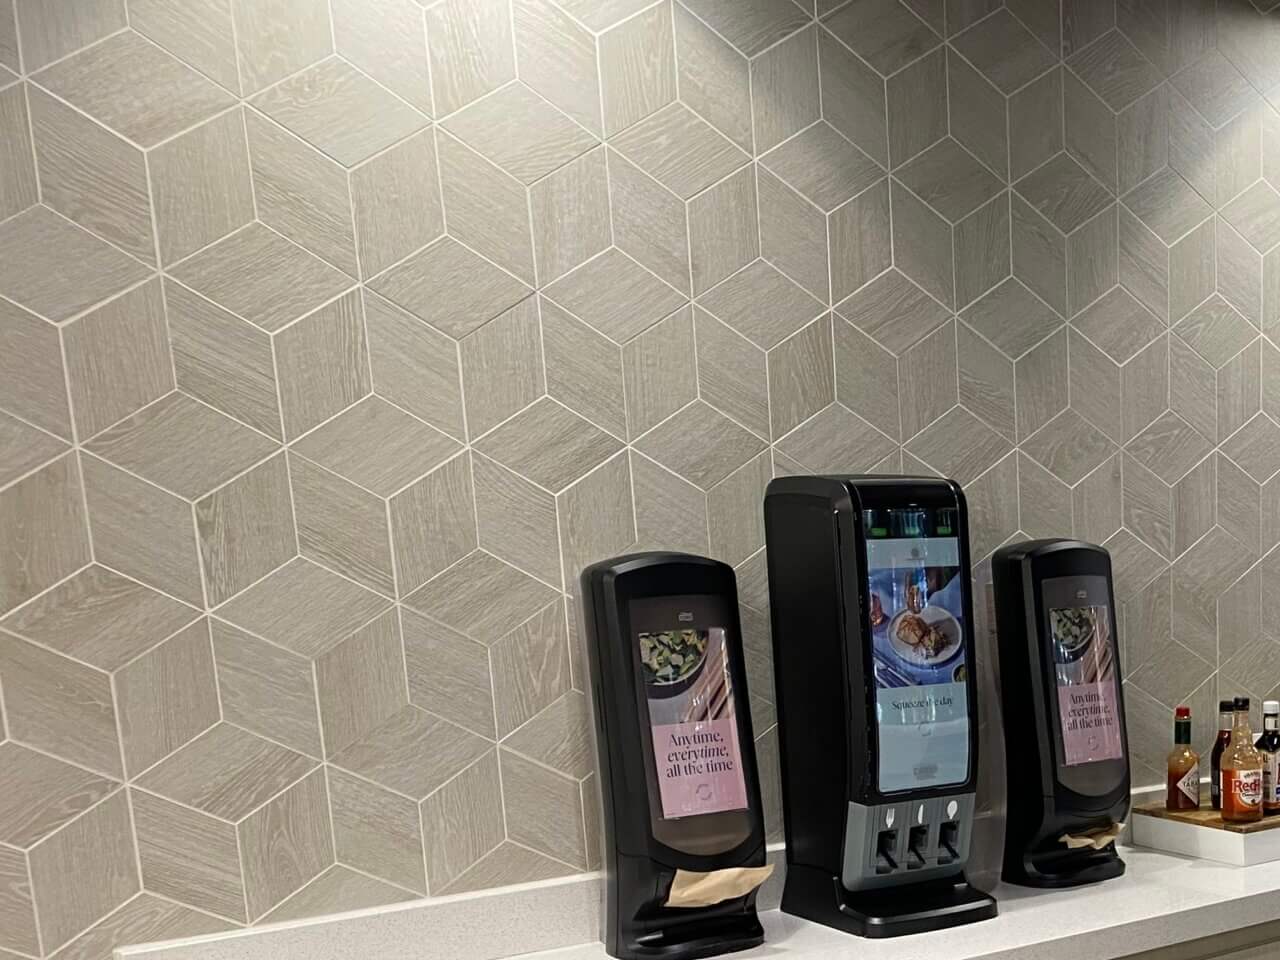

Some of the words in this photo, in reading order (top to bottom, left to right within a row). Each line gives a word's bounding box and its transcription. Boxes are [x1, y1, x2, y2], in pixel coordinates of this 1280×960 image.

[1070, 691, 1107, 706] Anytim,
[1080, 717, 1094, 729] the
[669, 731, 724, 749] Anytime,
[667, 745, 729, 763] everytime,
[666, 763, 681, 778] all
[684, 761, 703, 776] the
[706, 760, 734, 773] time
